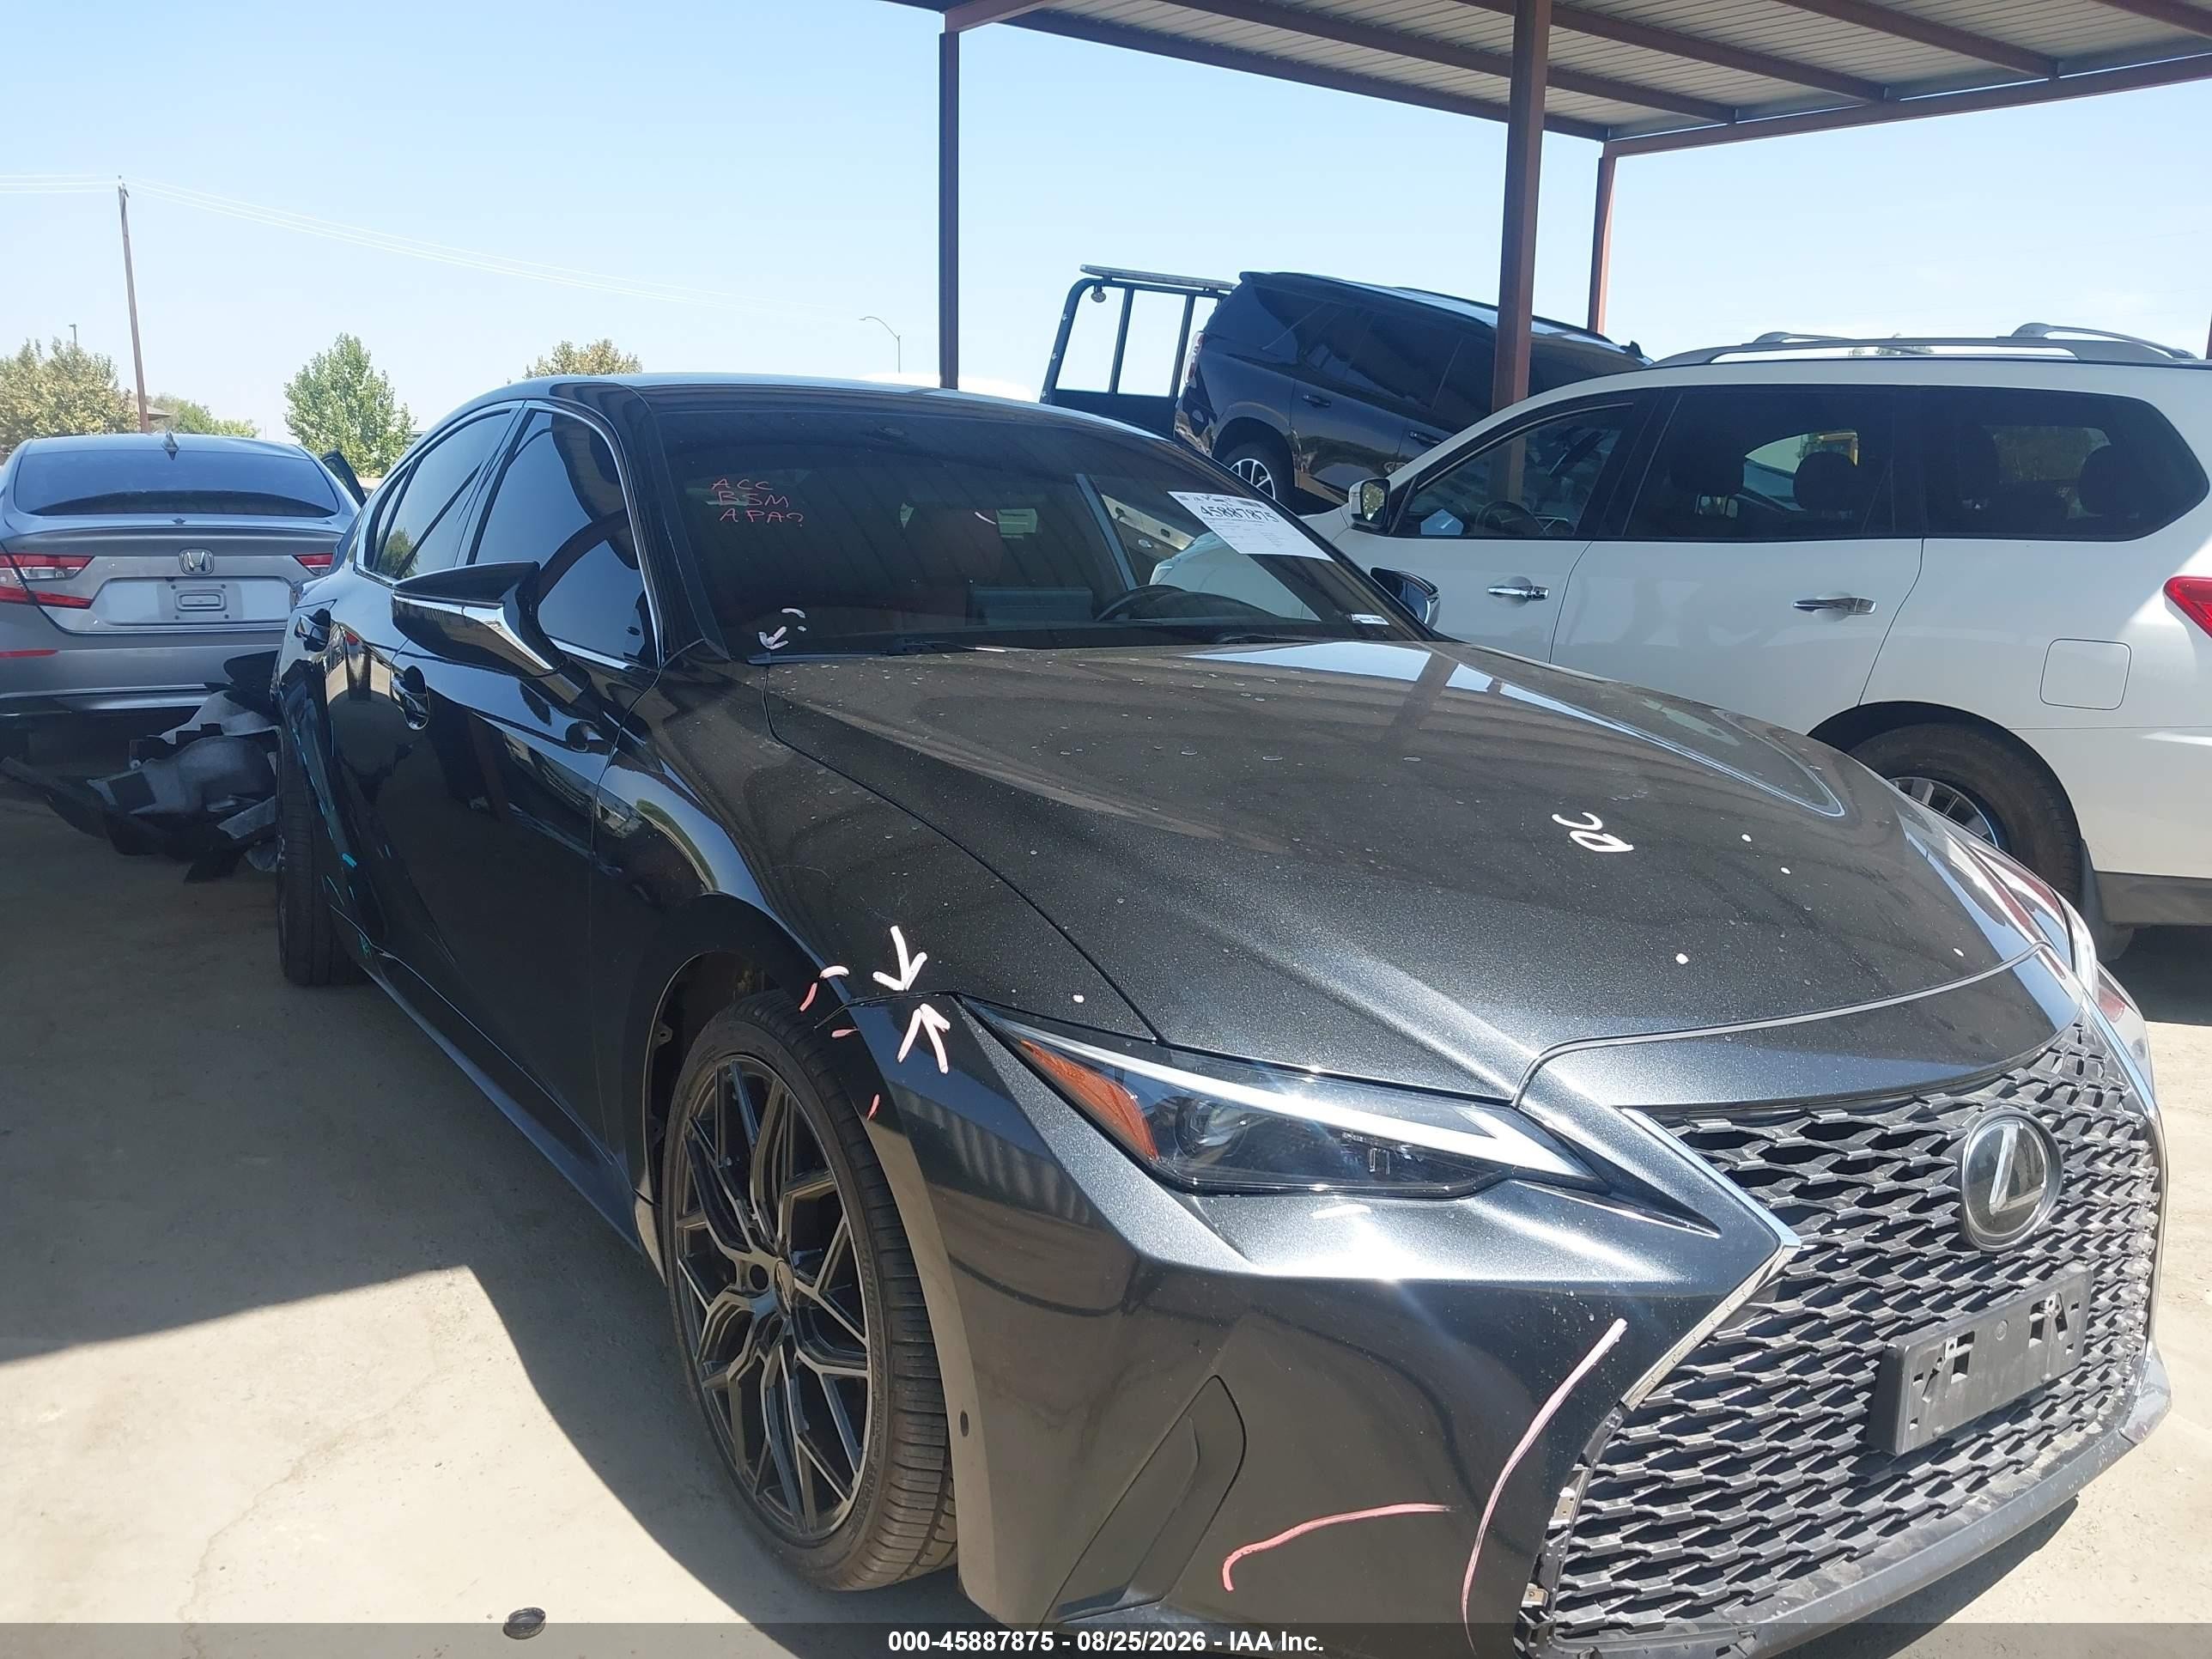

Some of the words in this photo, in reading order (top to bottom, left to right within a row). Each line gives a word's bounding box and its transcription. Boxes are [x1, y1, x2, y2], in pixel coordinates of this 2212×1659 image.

[711, 478, 774, 490] ACC
[718, 490, 789, 508] BSM
[1200, 505, 1279, 523] 45887875
